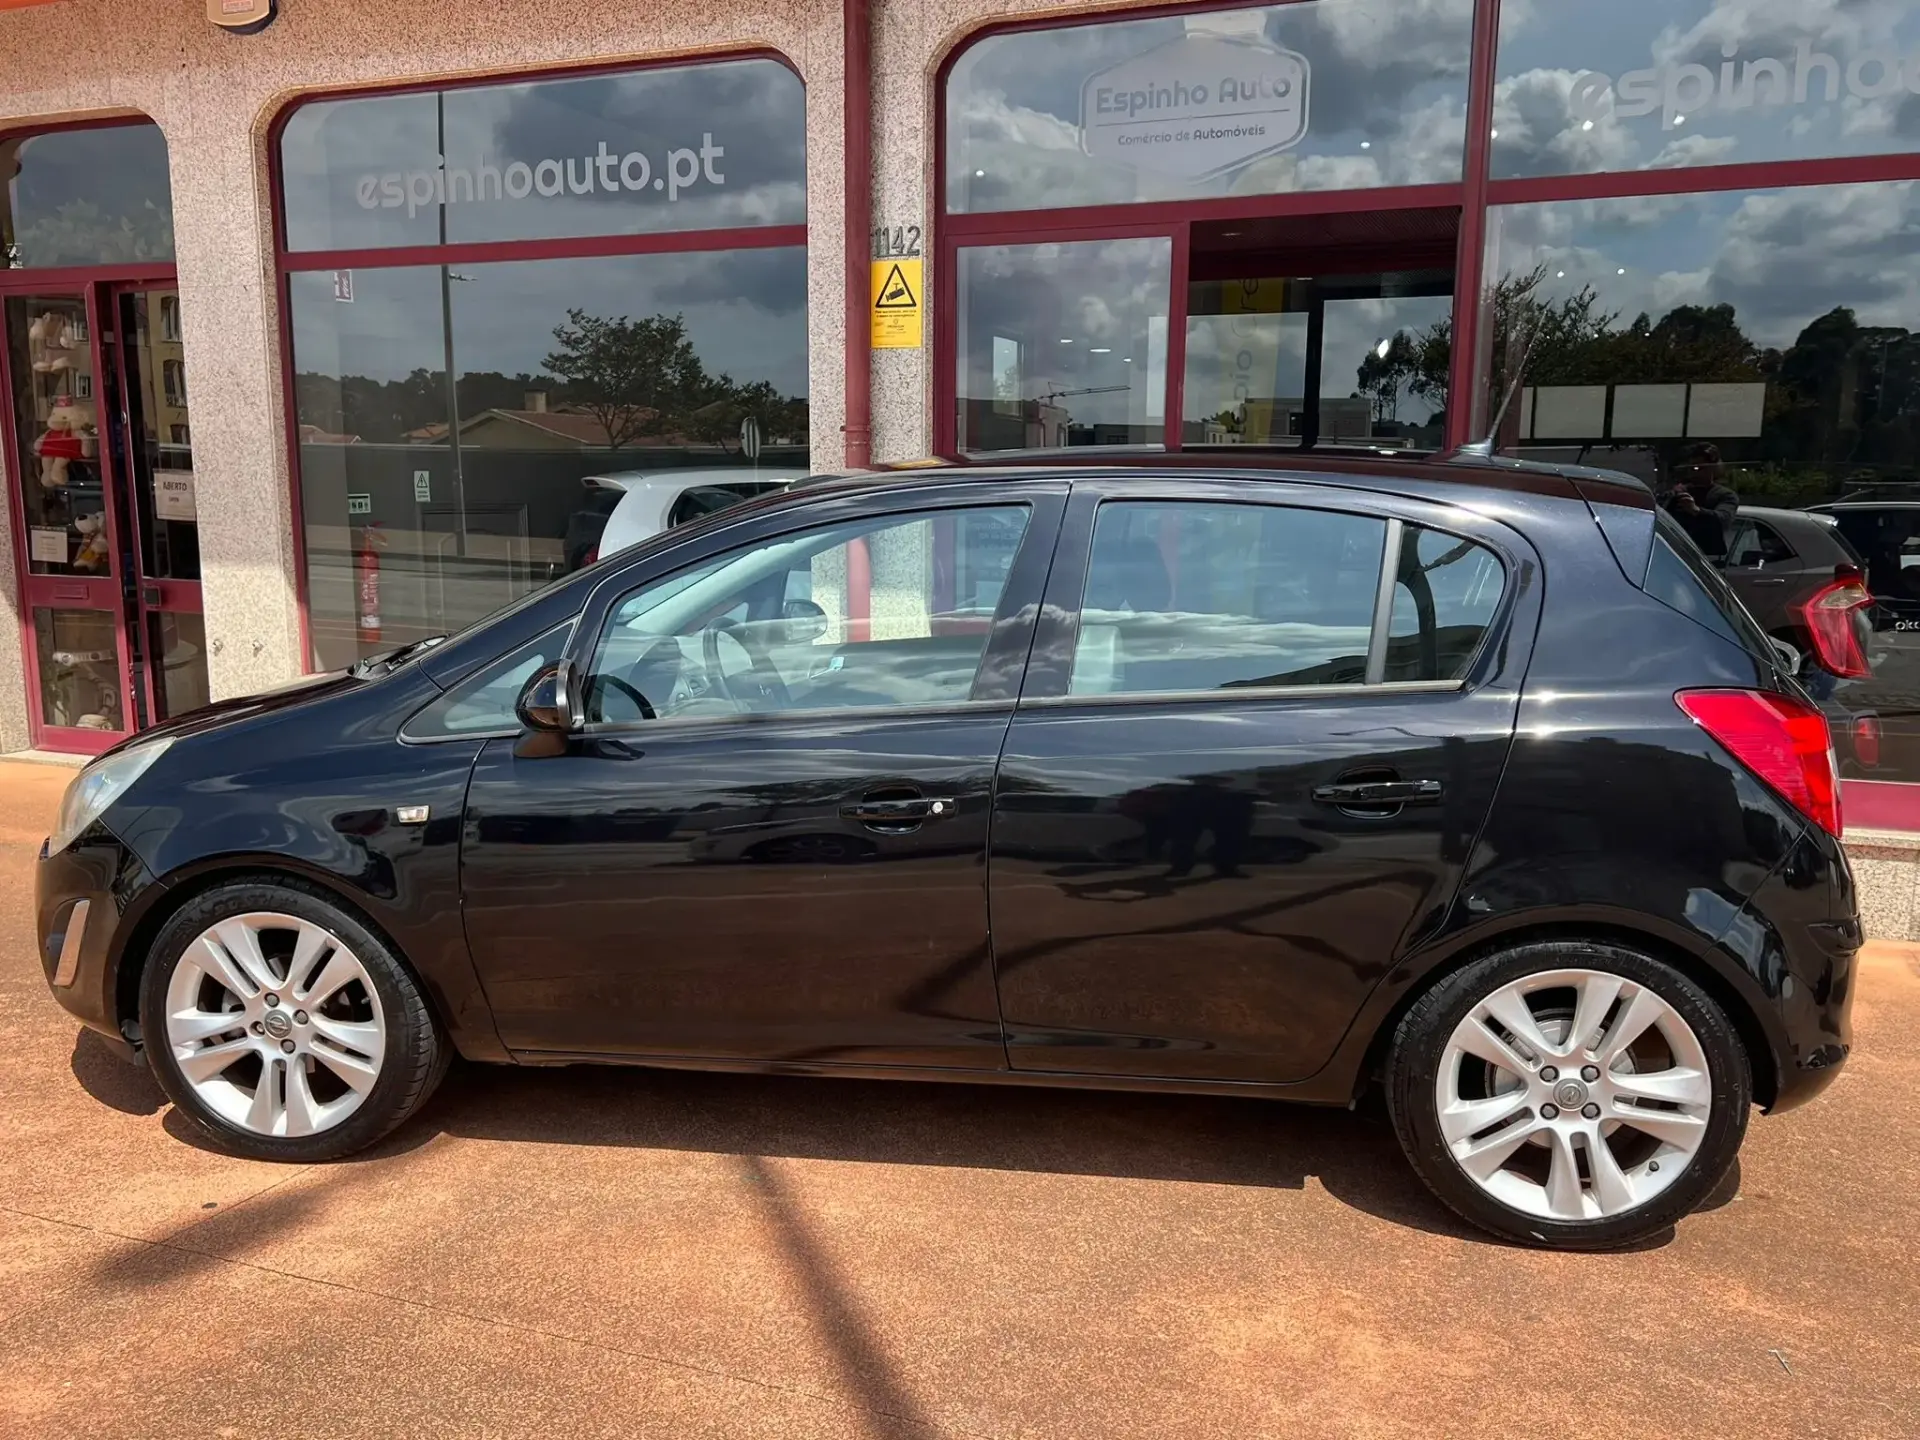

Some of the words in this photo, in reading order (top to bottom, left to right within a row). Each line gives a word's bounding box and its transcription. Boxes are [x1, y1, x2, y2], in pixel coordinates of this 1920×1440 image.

[1096, 80, 1209, 118] Espinho
[1219, 73, 1291, 103] Auto
[1118, 131, 1172, 146] Comércio
[1175, 129, 1190, 142] de
[1193, 124, 1266, 141] Automóveis
[356, 132, 725, 218] espinhoauto.pt
[875, 225, 921, 257] 1142
